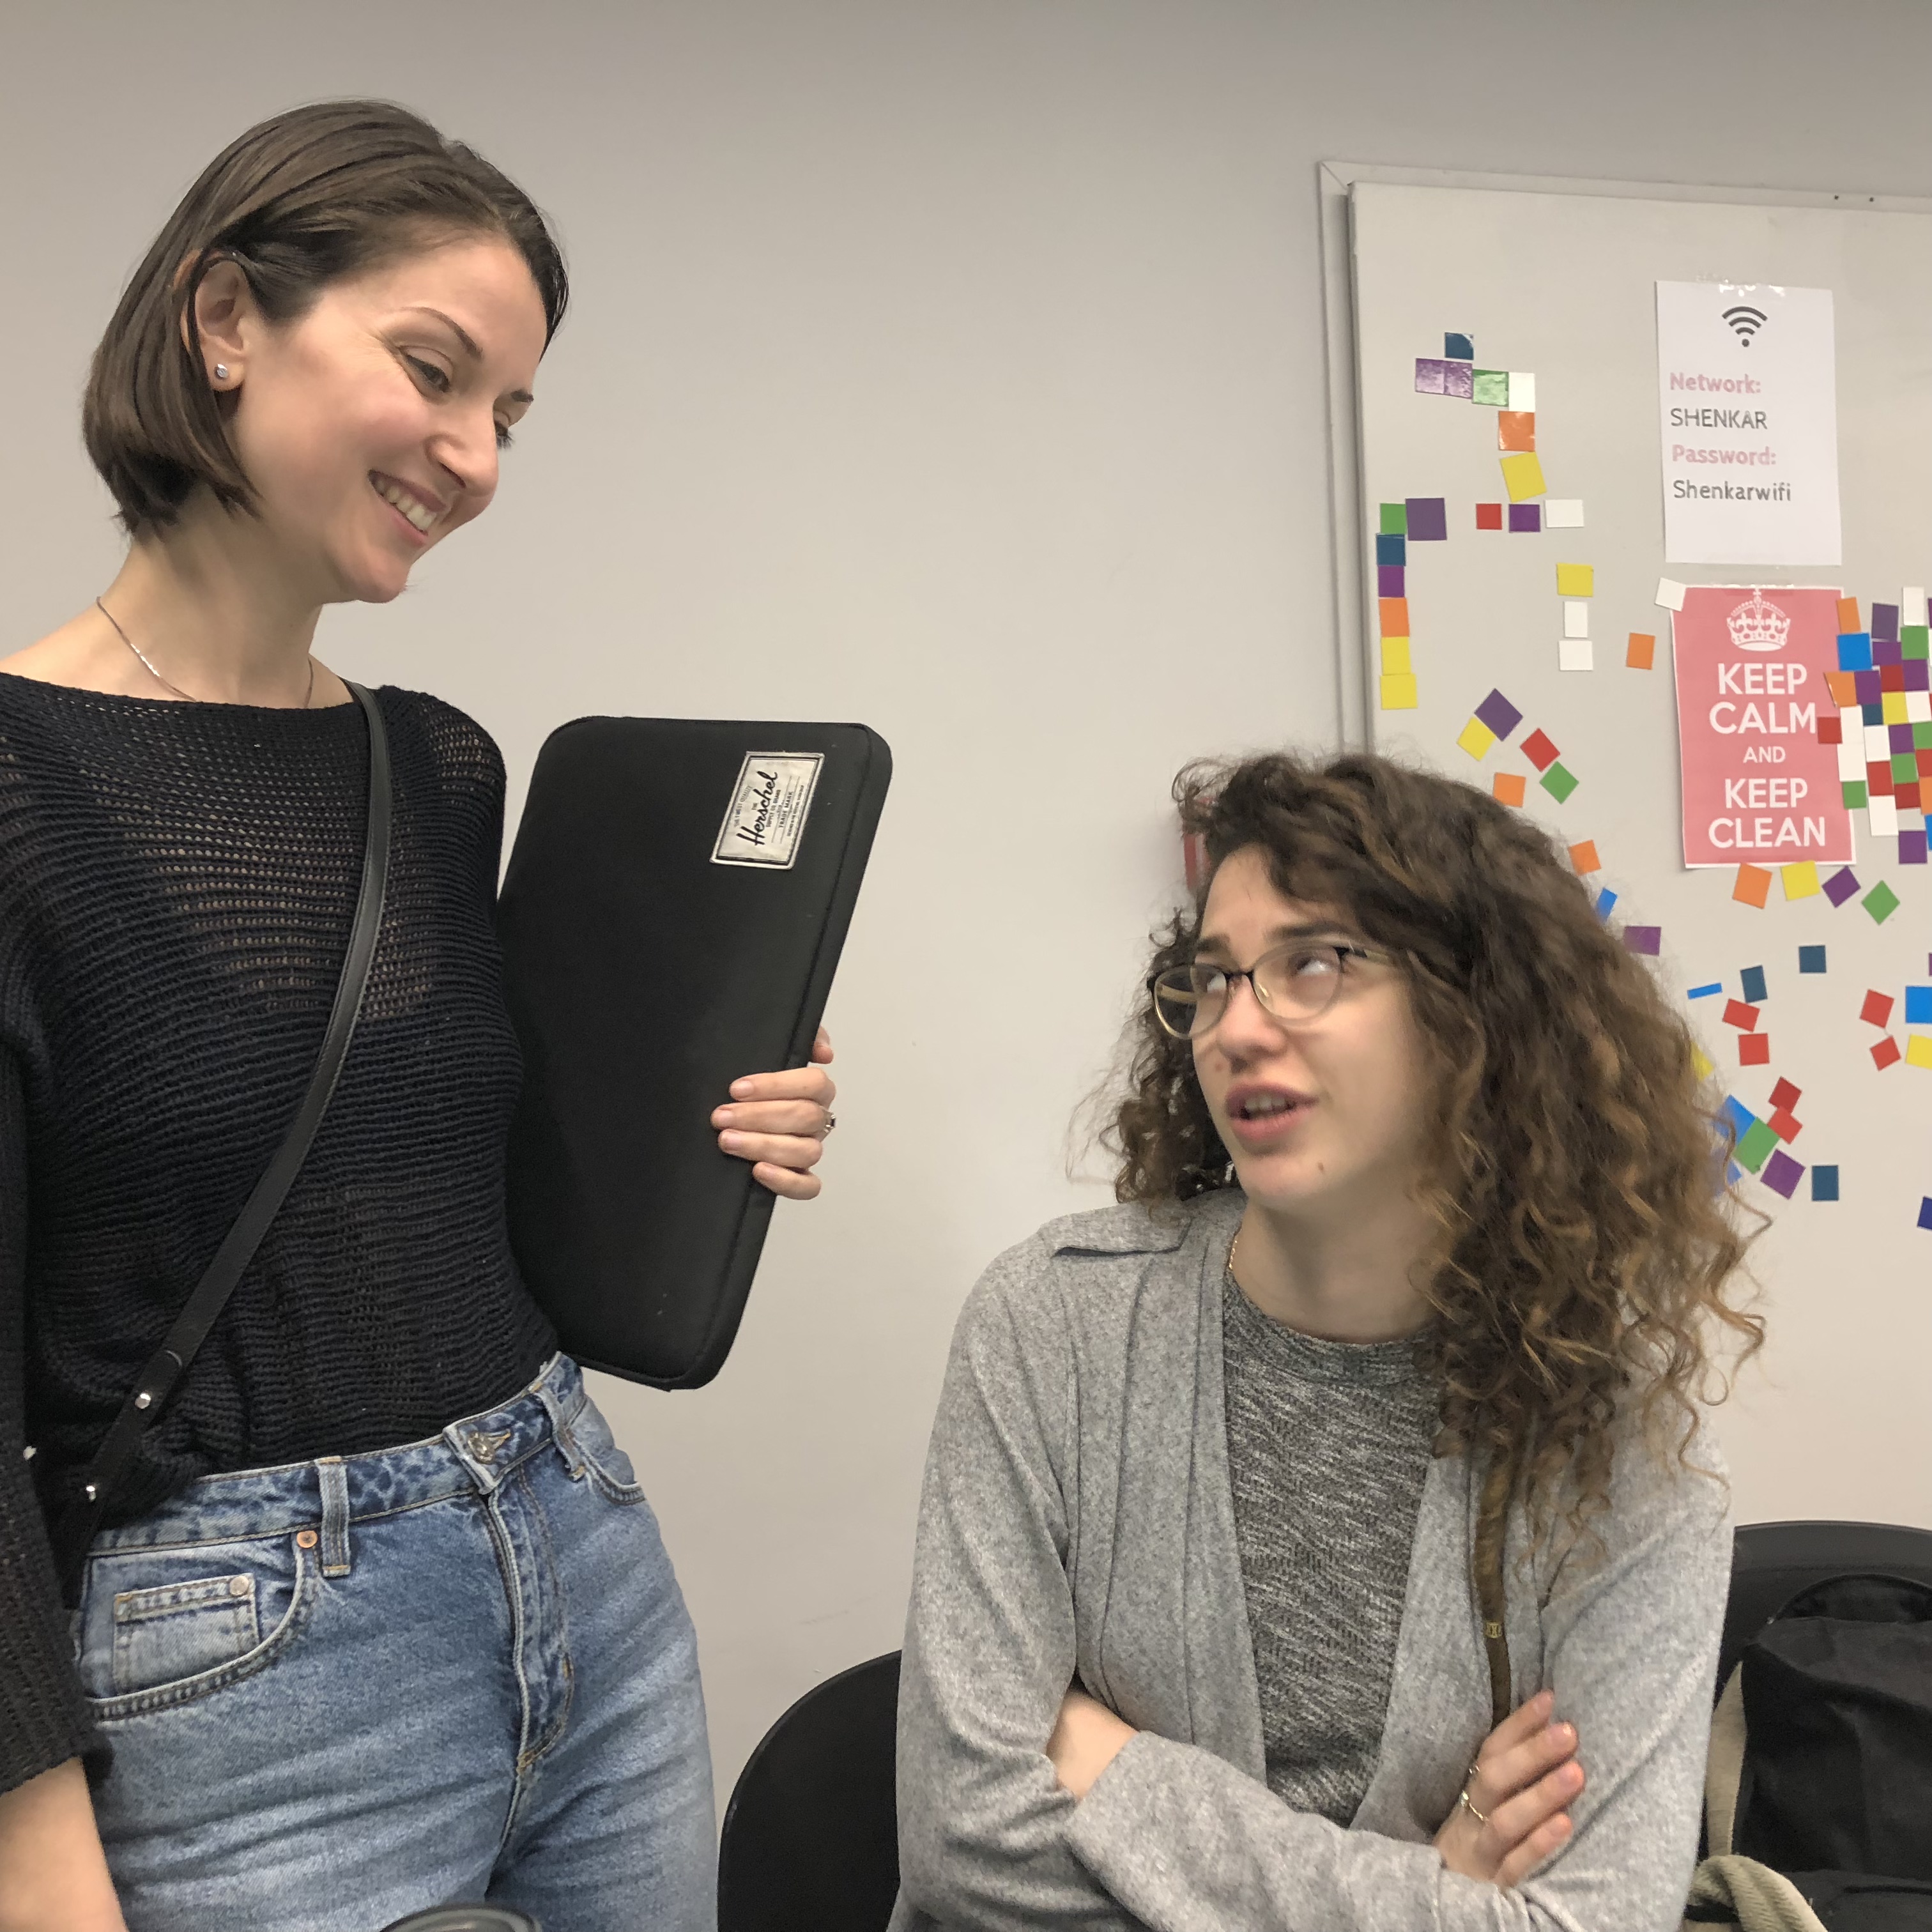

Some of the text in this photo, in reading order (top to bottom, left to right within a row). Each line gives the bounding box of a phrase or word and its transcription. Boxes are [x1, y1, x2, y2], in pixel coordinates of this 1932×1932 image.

[1670, 372, 1761, 394] Network:
[1670, 408, 1768, 429] SHENKAR
[1672, 444, 1776, 466] Password:
[1673, 479, 1791, 501] Shenkarwifi
[1718, 663, 1807, 694] KEEP
[1709, 702, 1816, 734] CALM
[1743, 746, 1786, 763] AND
[736, 770, 778, 846] Herschel
[1724, 778, 1808, 809] KEEP
[779, 810, 787, 828] TRADE
[784, 791, 793, 808] MARK
[1708, 816, 1825, 848] CLEAN
